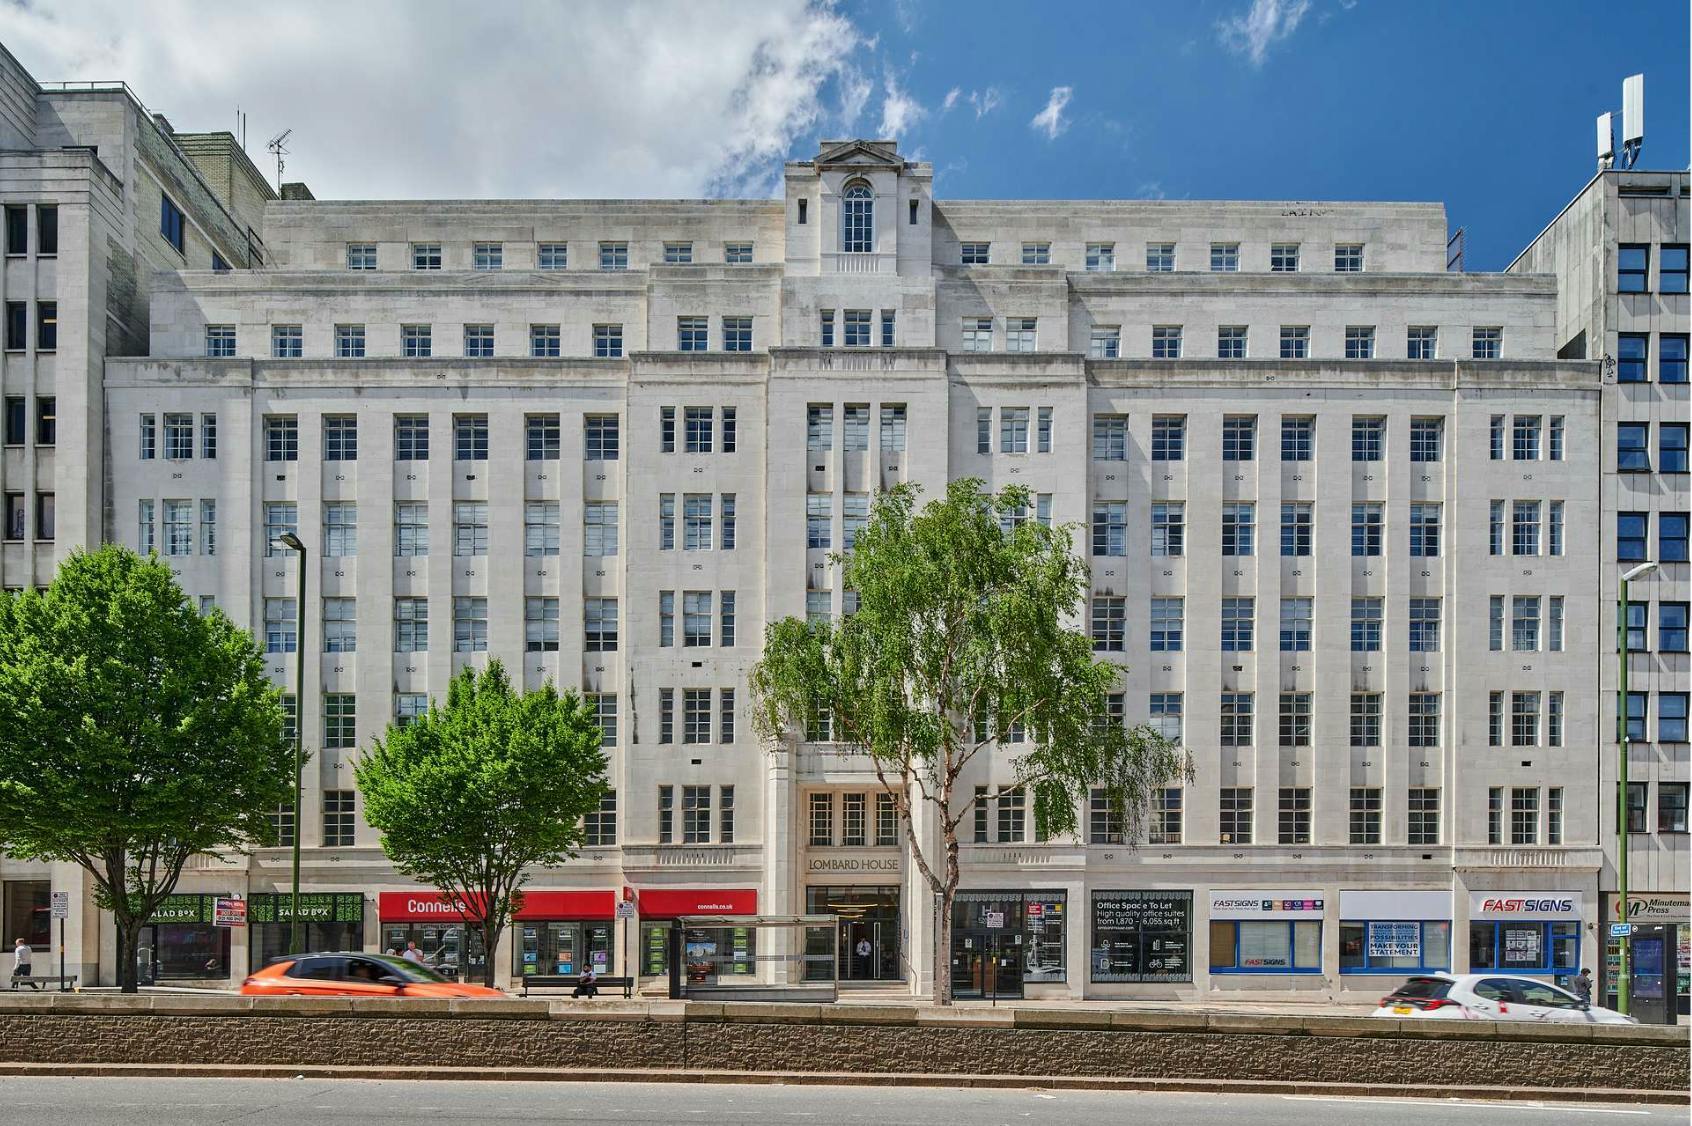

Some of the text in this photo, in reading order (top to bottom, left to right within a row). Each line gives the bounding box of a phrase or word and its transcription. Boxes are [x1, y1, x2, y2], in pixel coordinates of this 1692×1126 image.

[809, 859, 898, 870] LOMBARD HOUSE
[1482, 899, 1573, 912] FASTSIGNS
[1649, 899, 1690, 907] Minutema
[150, 910, 176, 918] ALAD
[1097, 910, 1114, 918] High
[1115, 910, 1140, 918] quality
[1647, 906, 1670, 914] Press
[1142, 918, 1162, 926] 6,055
[1163, 918, 1173, 926] sq
